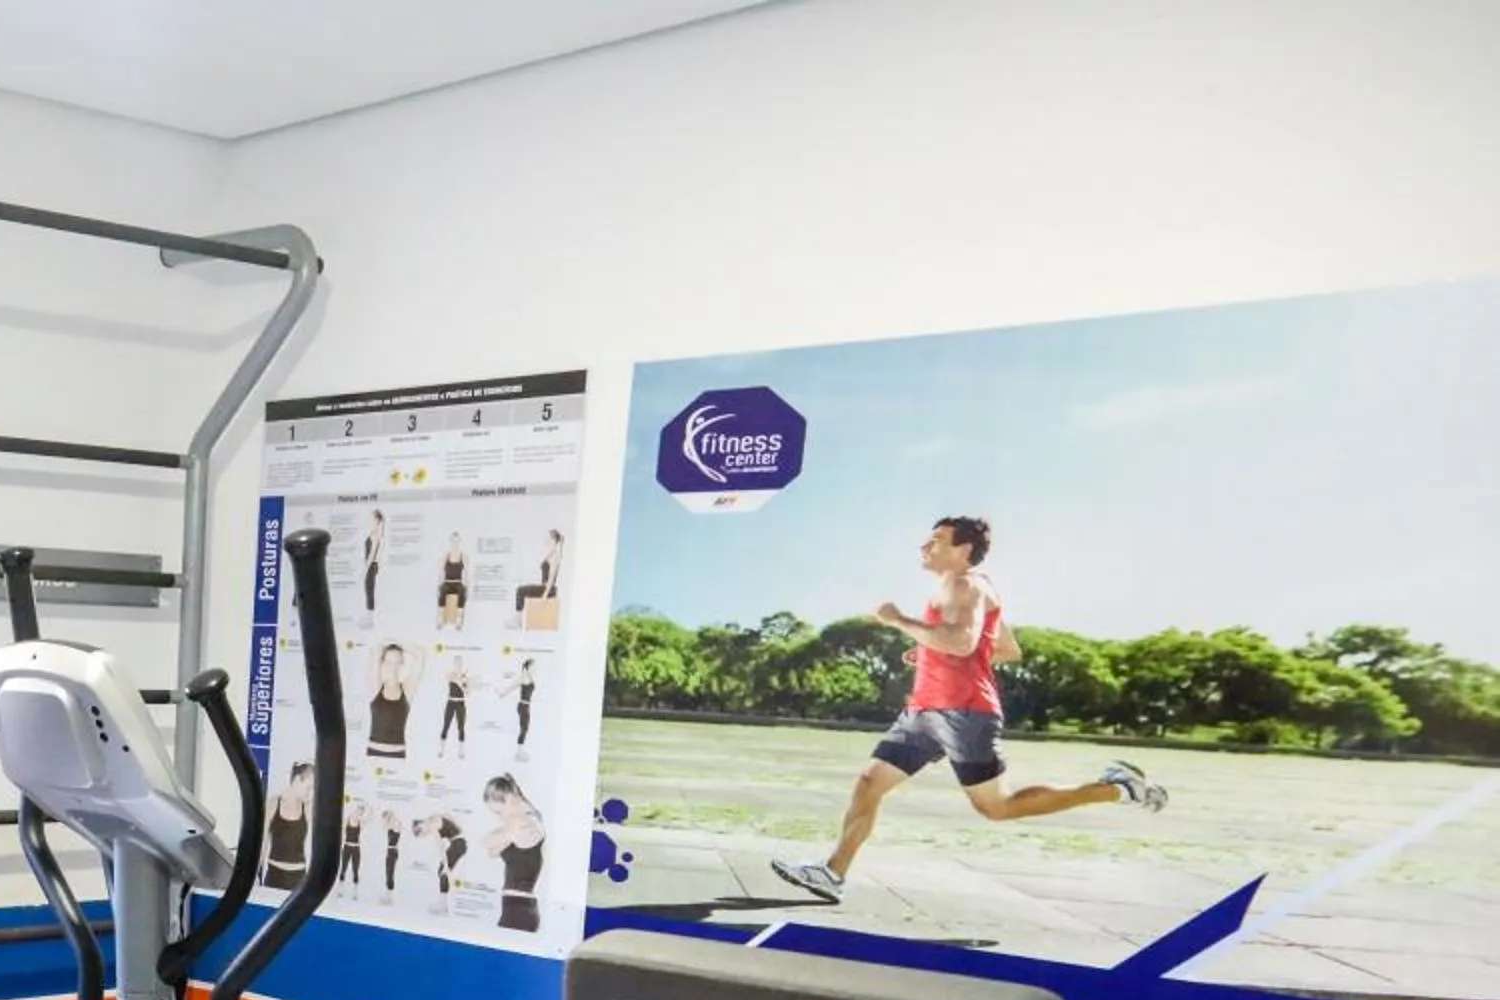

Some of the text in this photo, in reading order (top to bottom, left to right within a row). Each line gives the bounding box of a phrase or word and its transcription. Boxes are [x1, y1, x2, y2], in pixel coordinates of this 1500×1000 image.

[288, 403, 553, 441] 1 2 3 4 5
[701, 433, 783, 455] fitness
[725, 452, 779, 467] center
[259, 519, 279, 600] Posturas
[252, 636, 274, 735] Superiores
